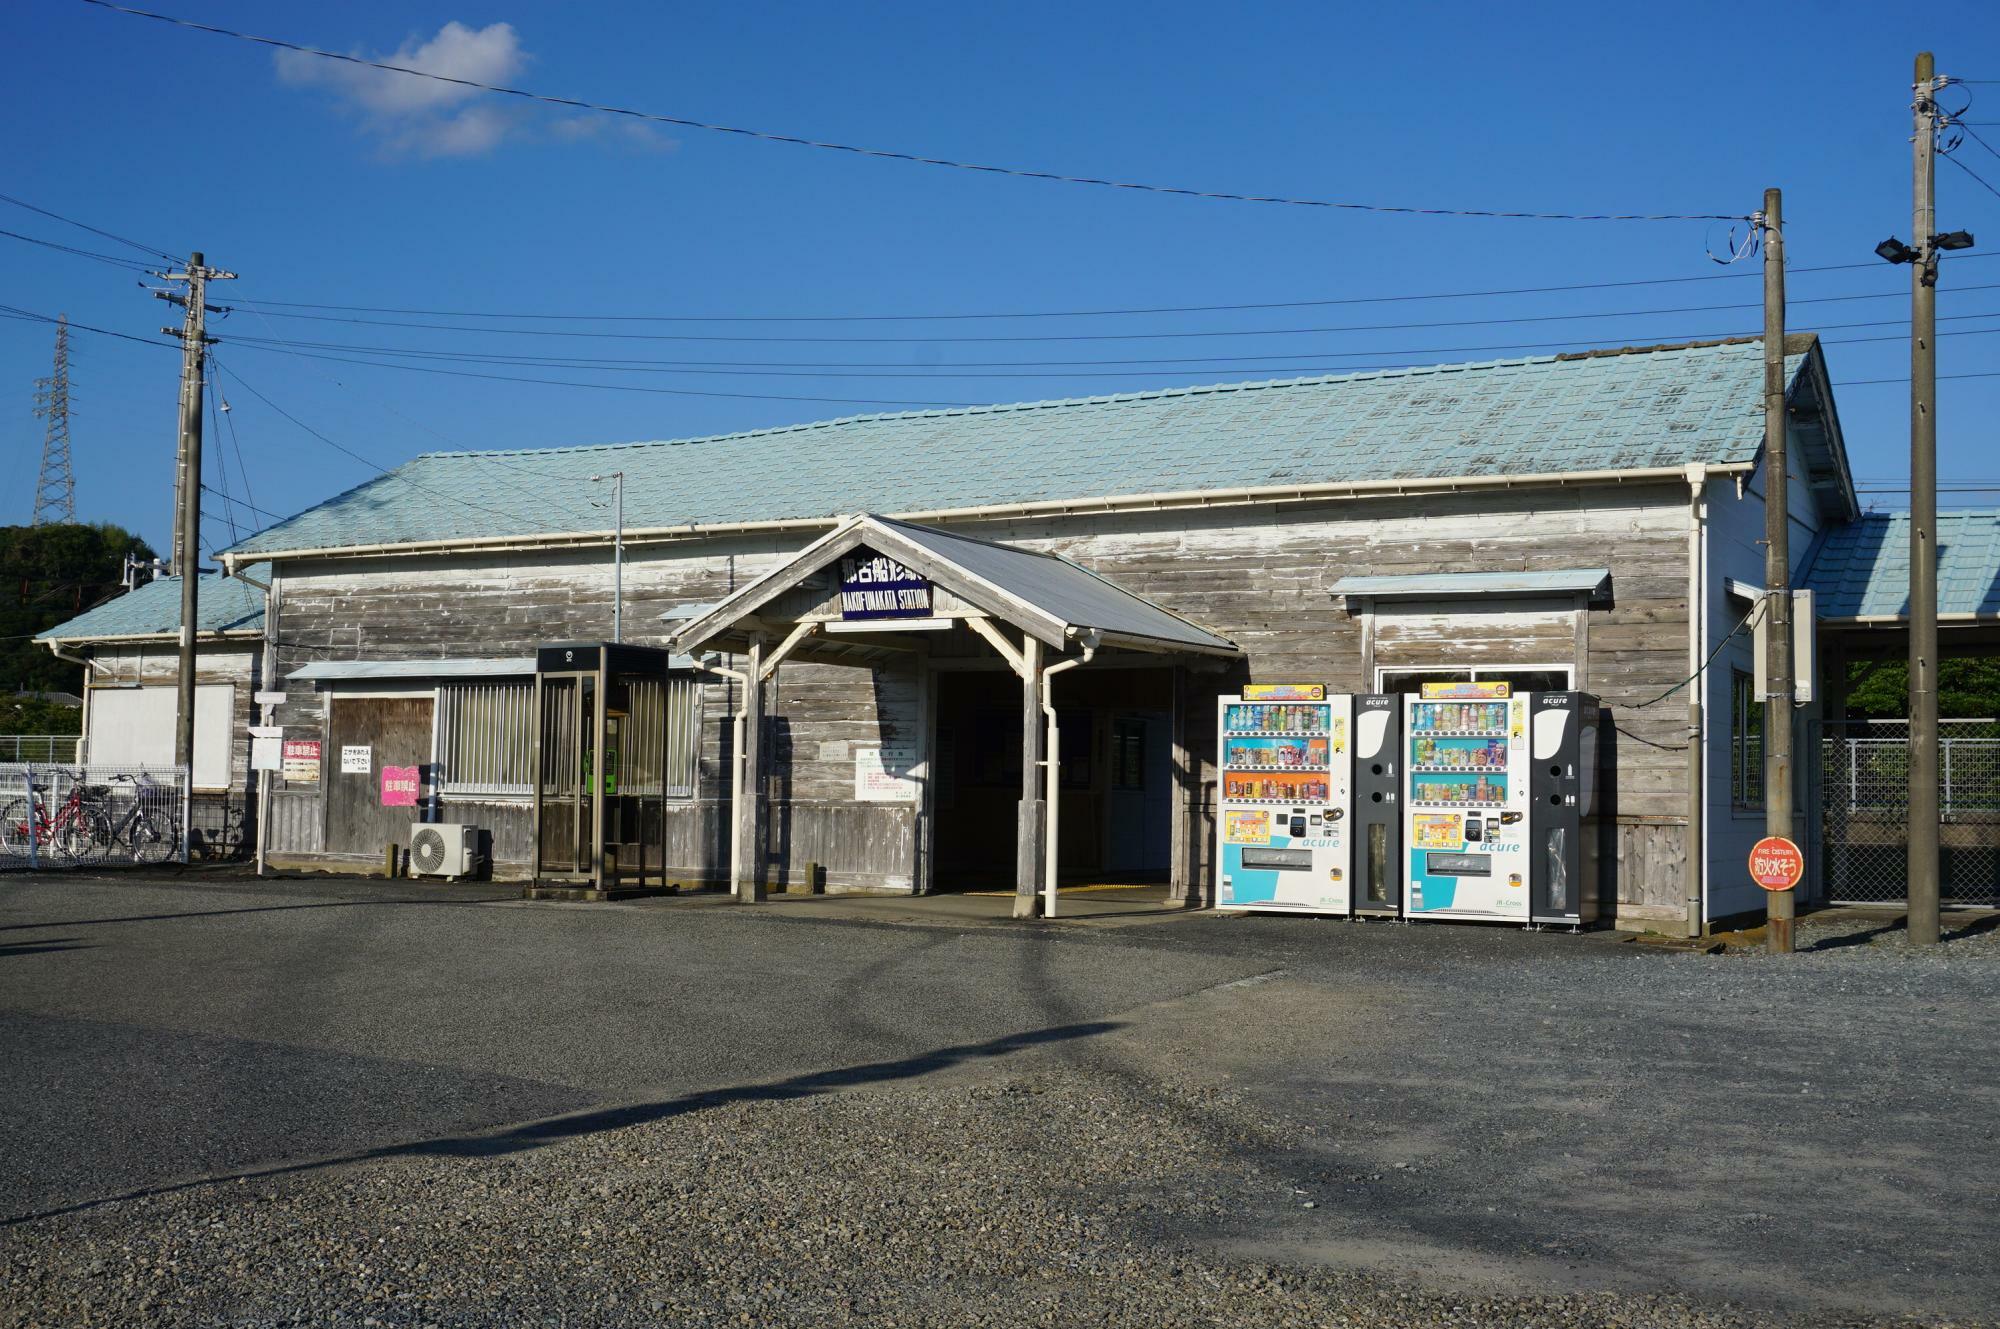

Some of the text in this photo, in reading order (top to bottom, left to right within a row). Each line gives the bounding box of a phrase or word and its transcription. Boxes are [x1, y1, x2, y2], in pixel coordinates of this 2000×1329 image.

[842, 589, 929, 611] NAKOFUNAKATA STATION
[385, 780, 416, 792] 駐車禁止
[1302, 838, 1340, 848] acure
[1479, 842, 1520, 853] acure
[1755, 858, 1796, 877] 防火水そう
